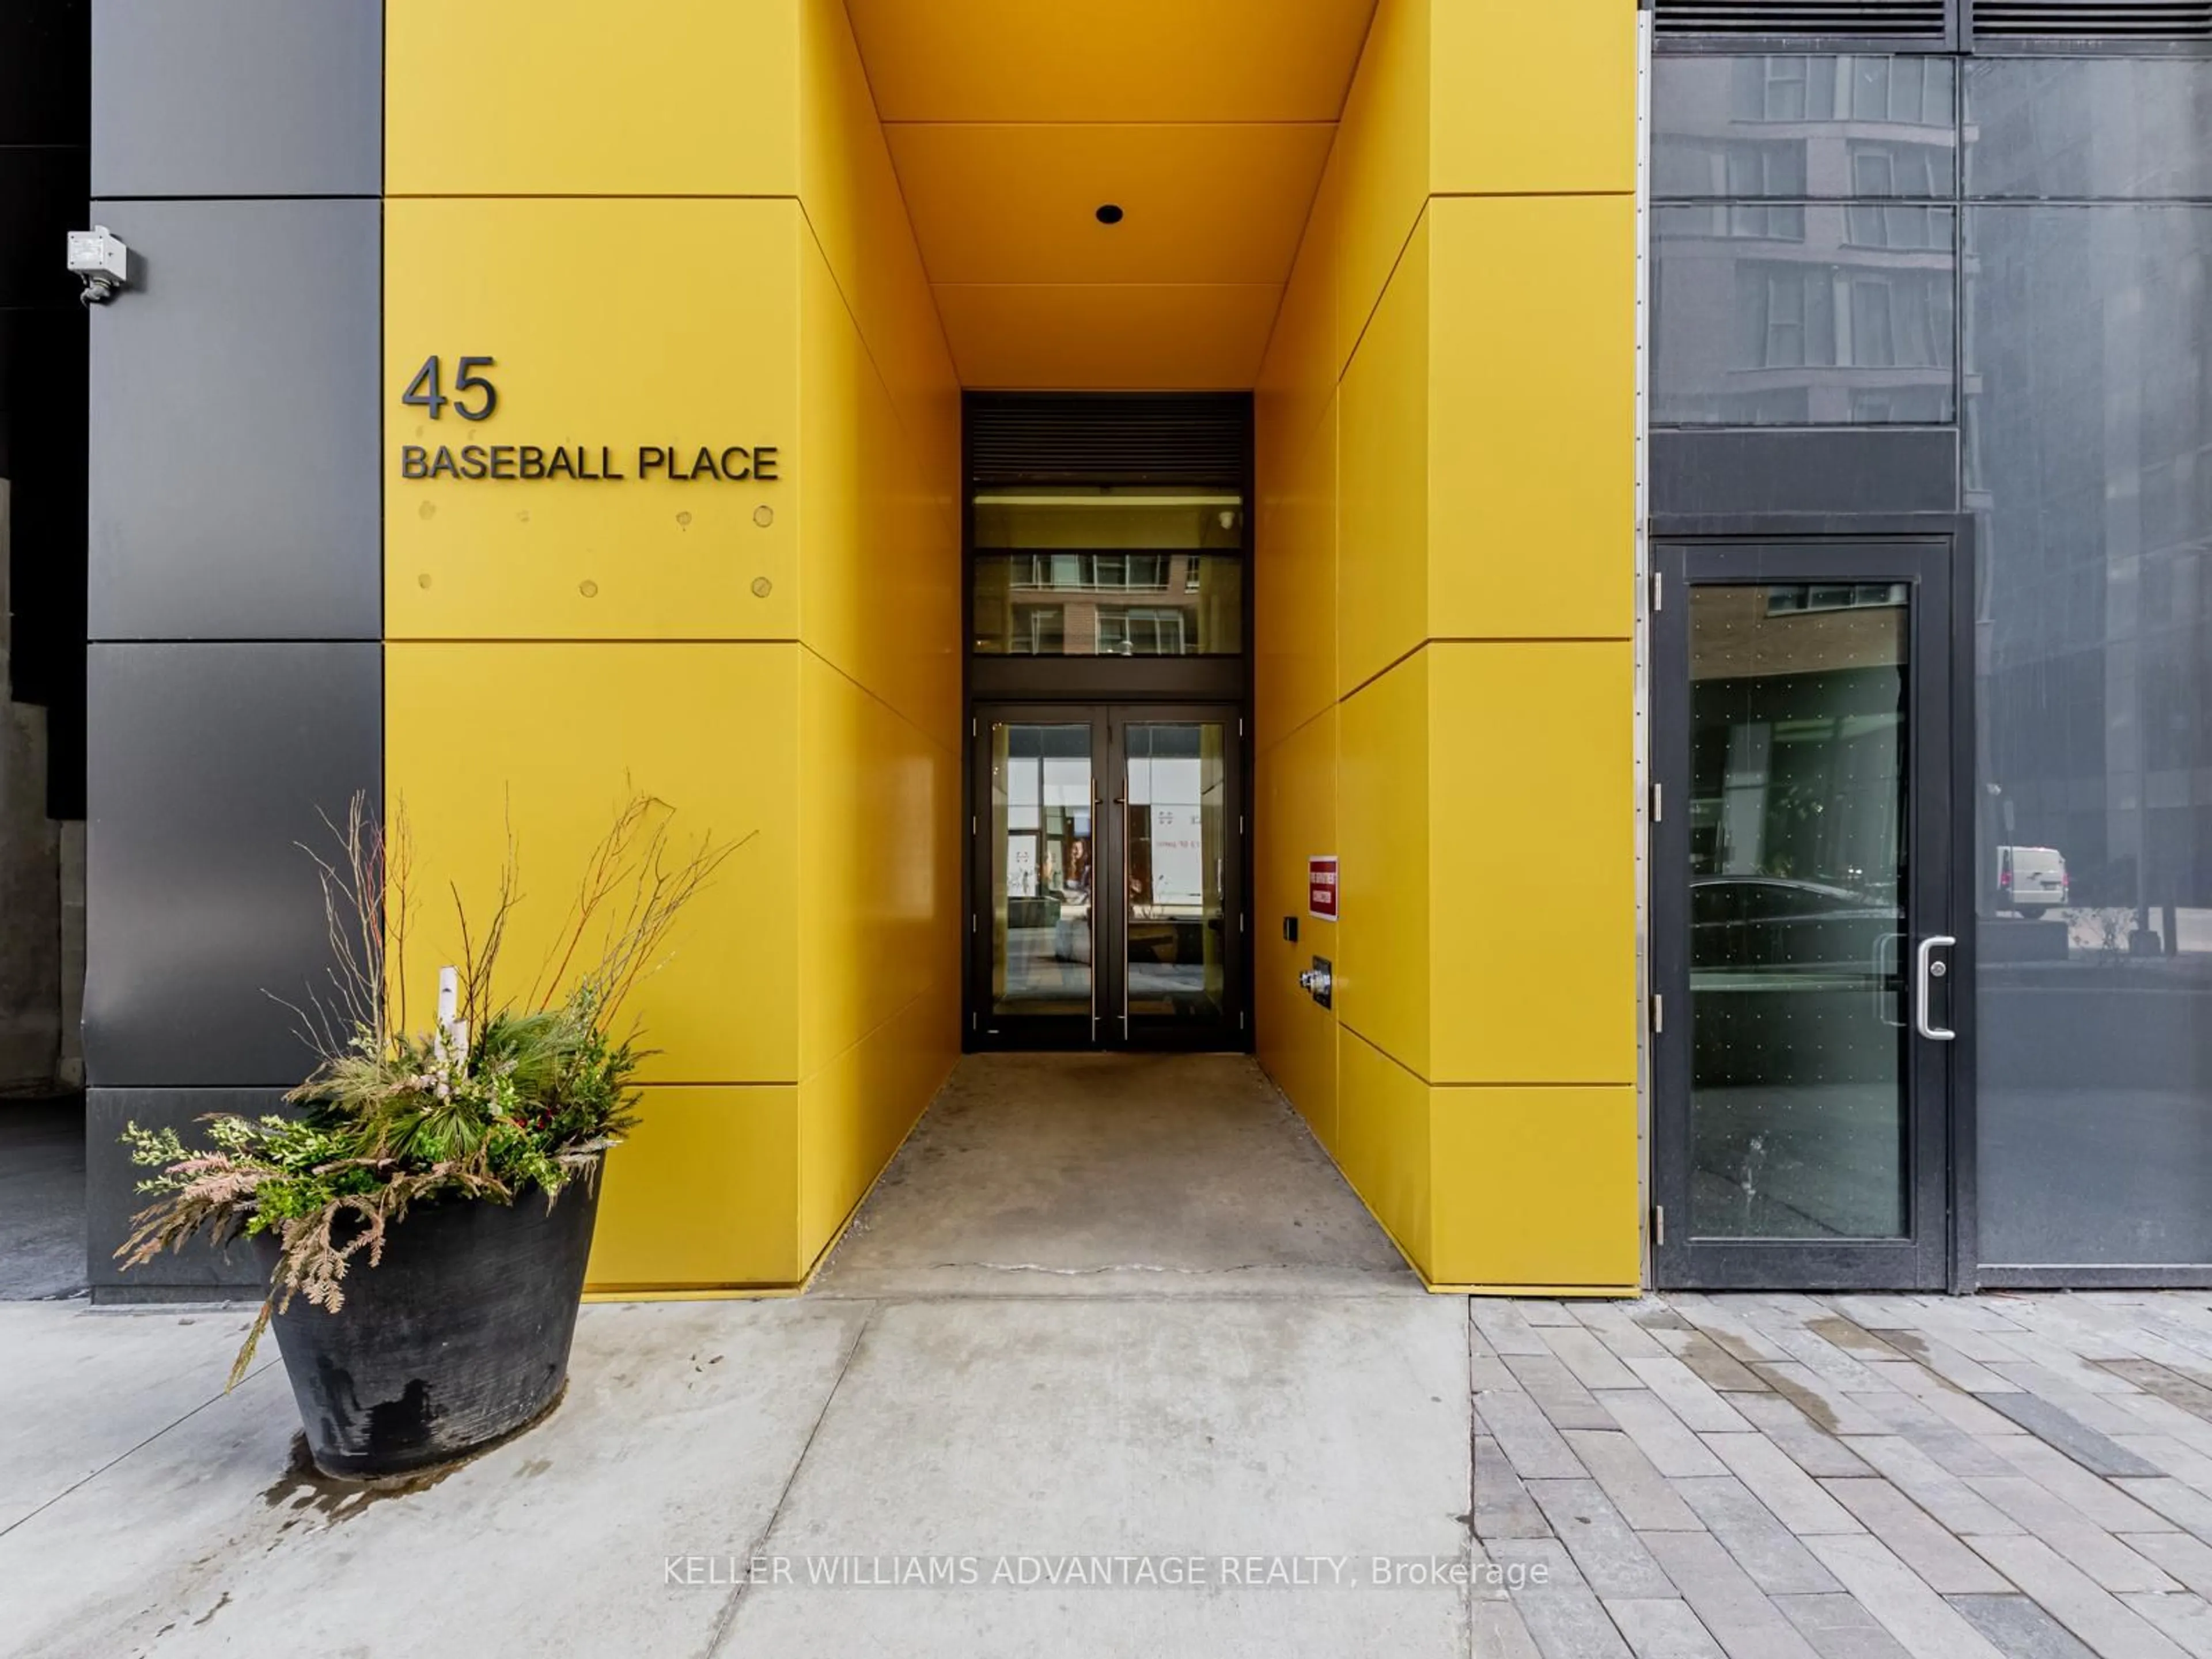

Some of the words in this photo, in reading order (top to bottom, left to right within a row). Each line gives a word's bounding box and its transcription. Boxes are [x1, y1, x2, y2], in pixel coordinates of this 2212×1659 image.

[402, 355, 498, 421] 45
[402, 445, 623, 479] BASEBALL
[638, 446, 778, 480] PLACE
